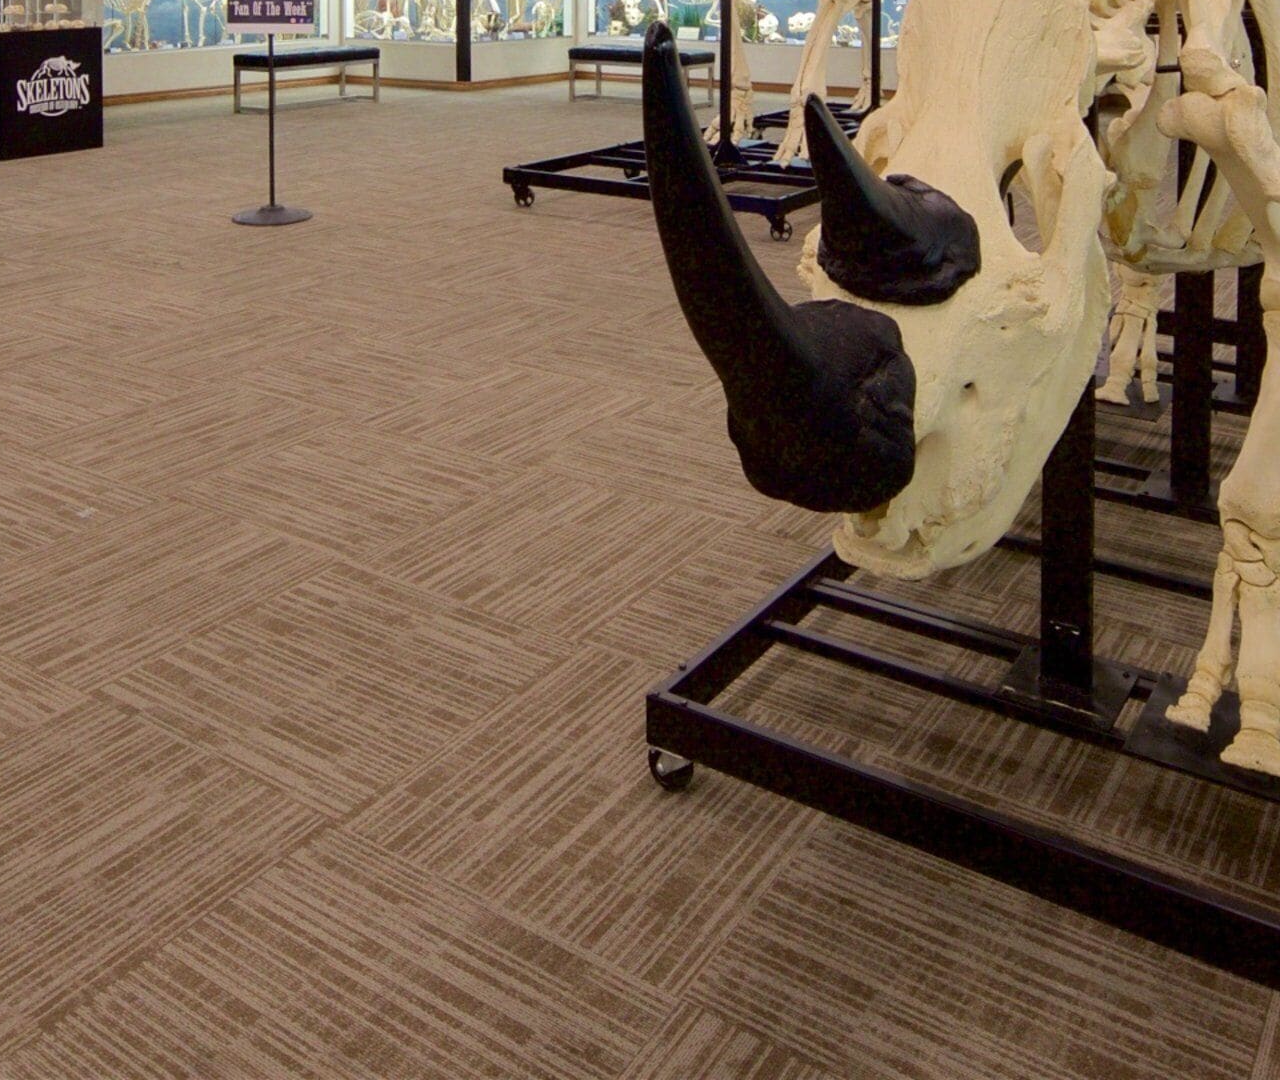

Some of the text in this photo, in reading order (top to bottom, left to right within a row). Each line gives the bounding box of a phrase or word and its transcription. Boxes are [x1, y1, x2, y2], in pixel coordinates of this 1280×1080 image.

[252, 1, 262, 16] Of
[265, 1, 281, 16] The
[16, 74, 91, 112] SKELETONS
